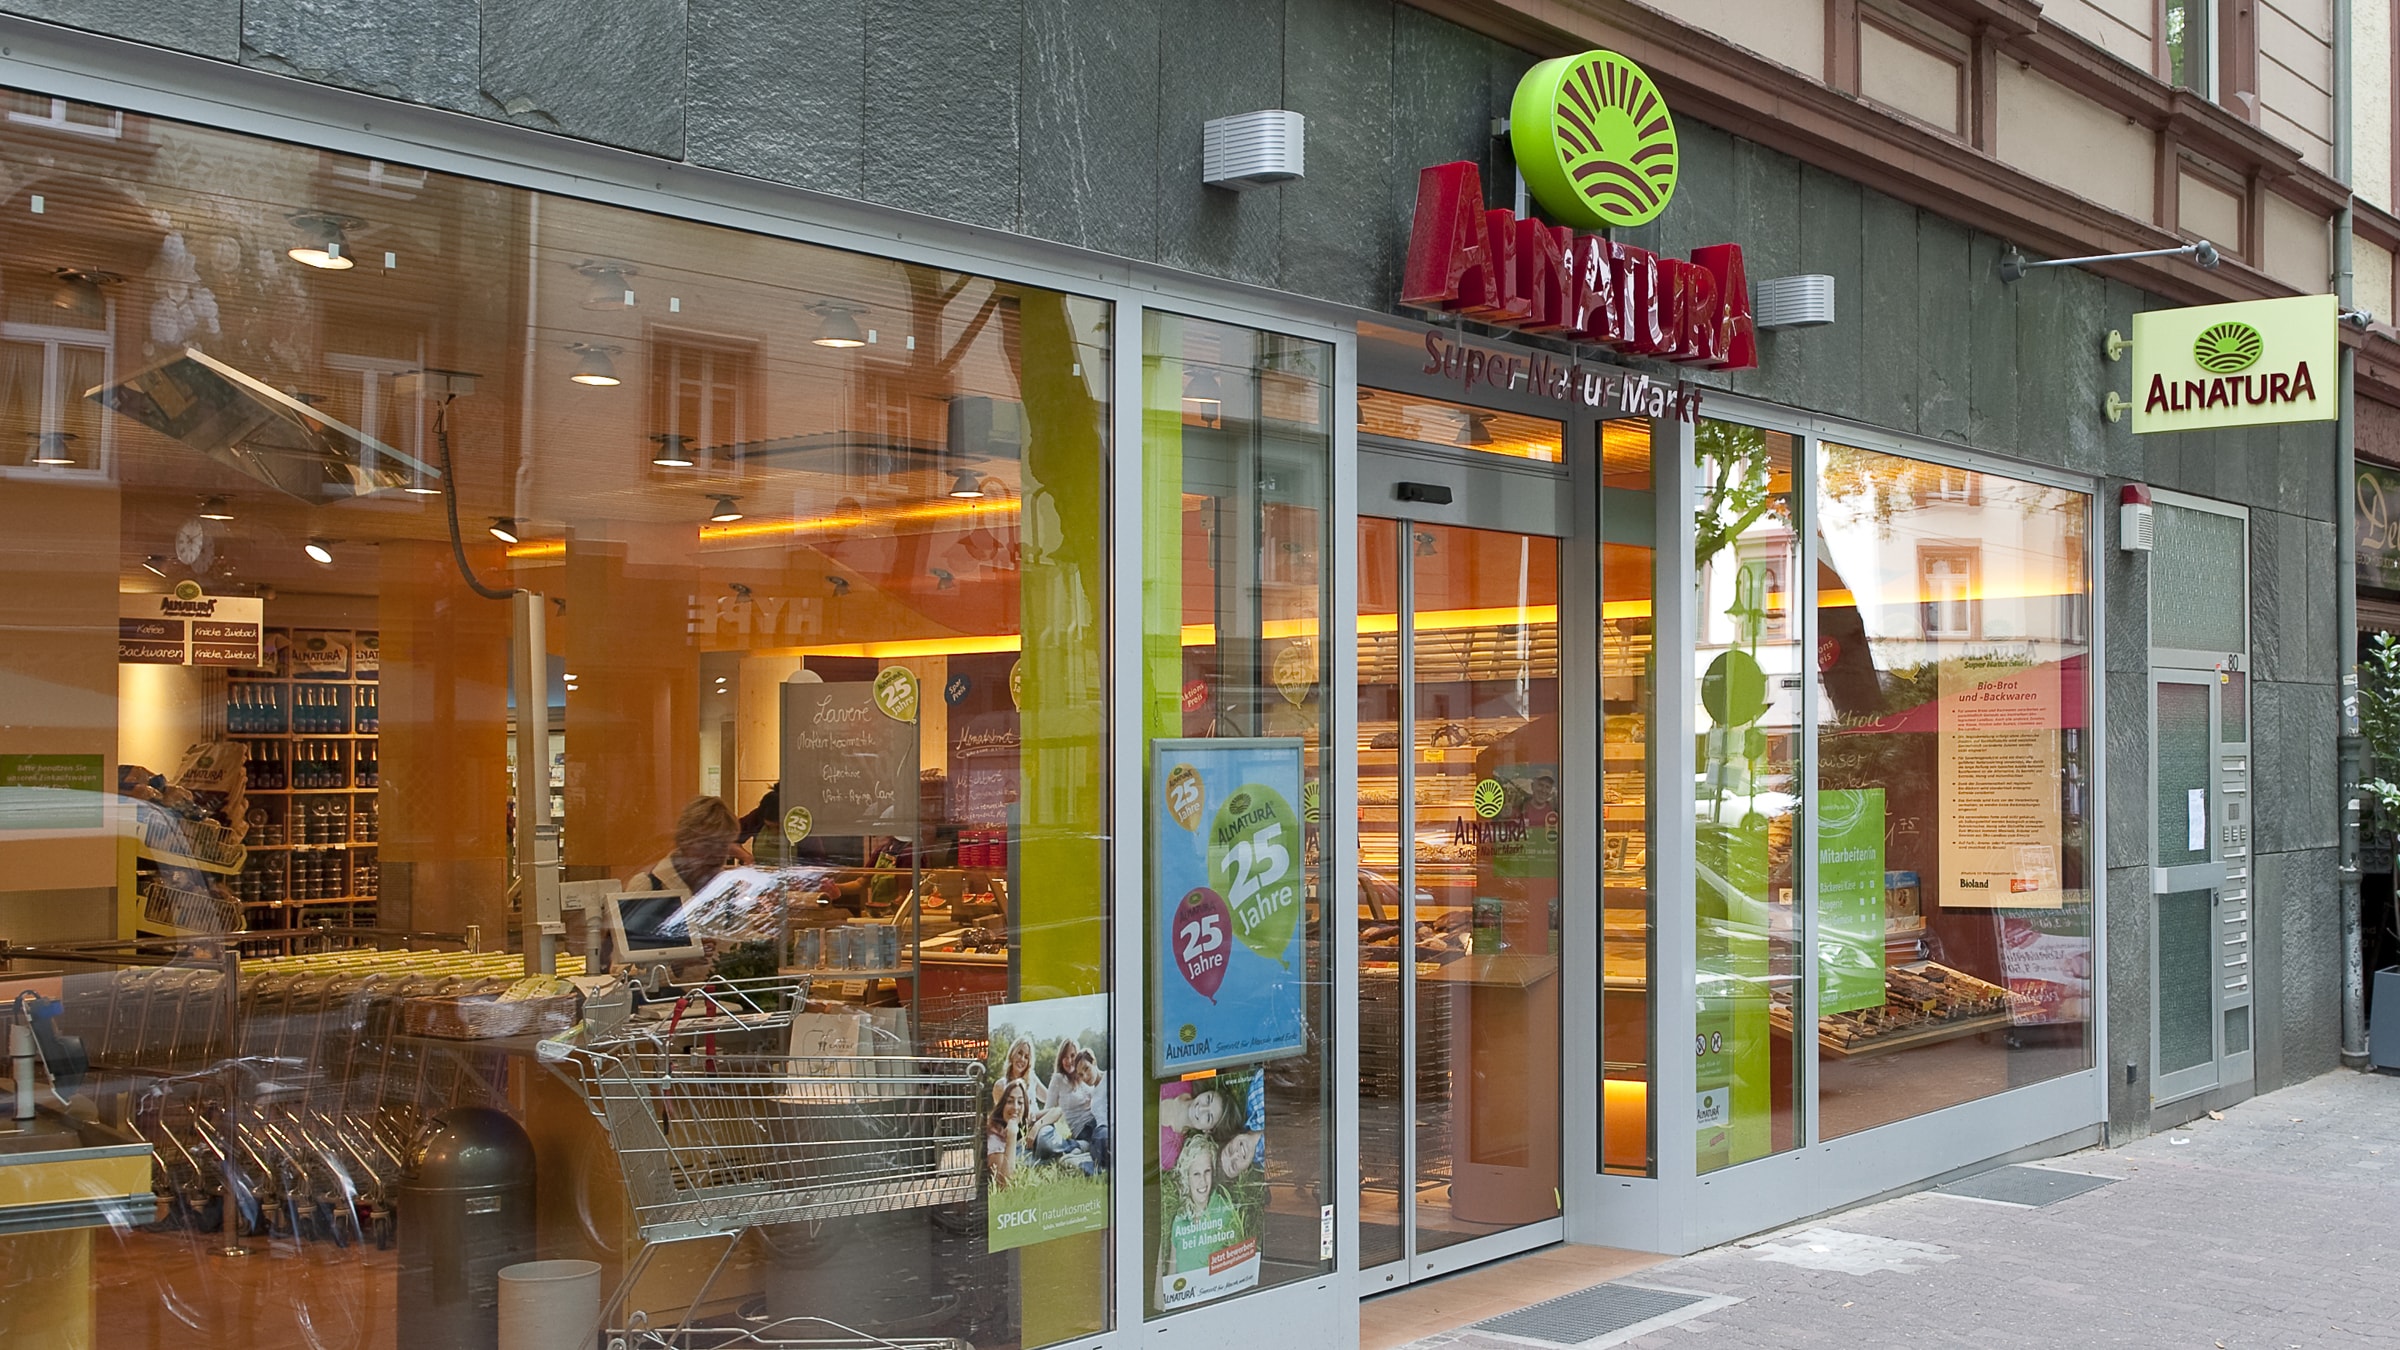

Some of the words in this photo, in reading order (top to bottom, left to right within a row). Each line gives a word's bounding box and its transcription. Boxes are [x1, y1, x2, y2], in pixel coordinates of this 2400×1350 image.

[1400, 160, 1759, 371] ALNATURA
[1423, 329, 1521, 394] Super
[1527, 350, 1617, 407] Natur
[1619, 369, 1703, 425] Markt
[2144, 361, 2316, 413] ALNATURA
[118, 643, 184, 660] Backwaren
[2228, 654, 2239, 672] 80
[880, 677, 912, 710] 25
[1958, 692, 1978, 702] und
[1979, 691, 2038, 702] -Backwaren
[1977, 681, 2019, 690] Bio-Brot
[891, 694, 915, 716] Jahre
[1818, 753, 1869, 770] aiser
[1170, 777, 1199, 812] 25
[787, 815, 808, 831] 25
[1177, 802, 1201, 822] Jahre
[1216, 801, 1277, 848] ALNATURA
[1454, 813, 1528, 846] ALNATURA
[1458, 846, 1478, 859] Super
[1220, 822, 1290, 910] 25
[1960, 879, 1989, 888] Bioland
[1238, 885, 1293, 936] Jahre
[1179, 914, 1223, 964] 25
[1187, 952, 1224, 980] Jahre
[1165, 1038, 1211, 1060] ALNATURA
[1696, 1105, 1720, 1120] ALNATURA
[997, 1208, 1037, 1230] SPEICK
[1042, 1198, 1101, 1221] naturkosmetik
[1175, 1218, 1223, 1238] Ausbildung
[1182, 1238, 1197, 1250] bei
[1198, 1229, 1235, 1247] Alnatura
[1211, 1254, 1226, 1265] Jetzt
